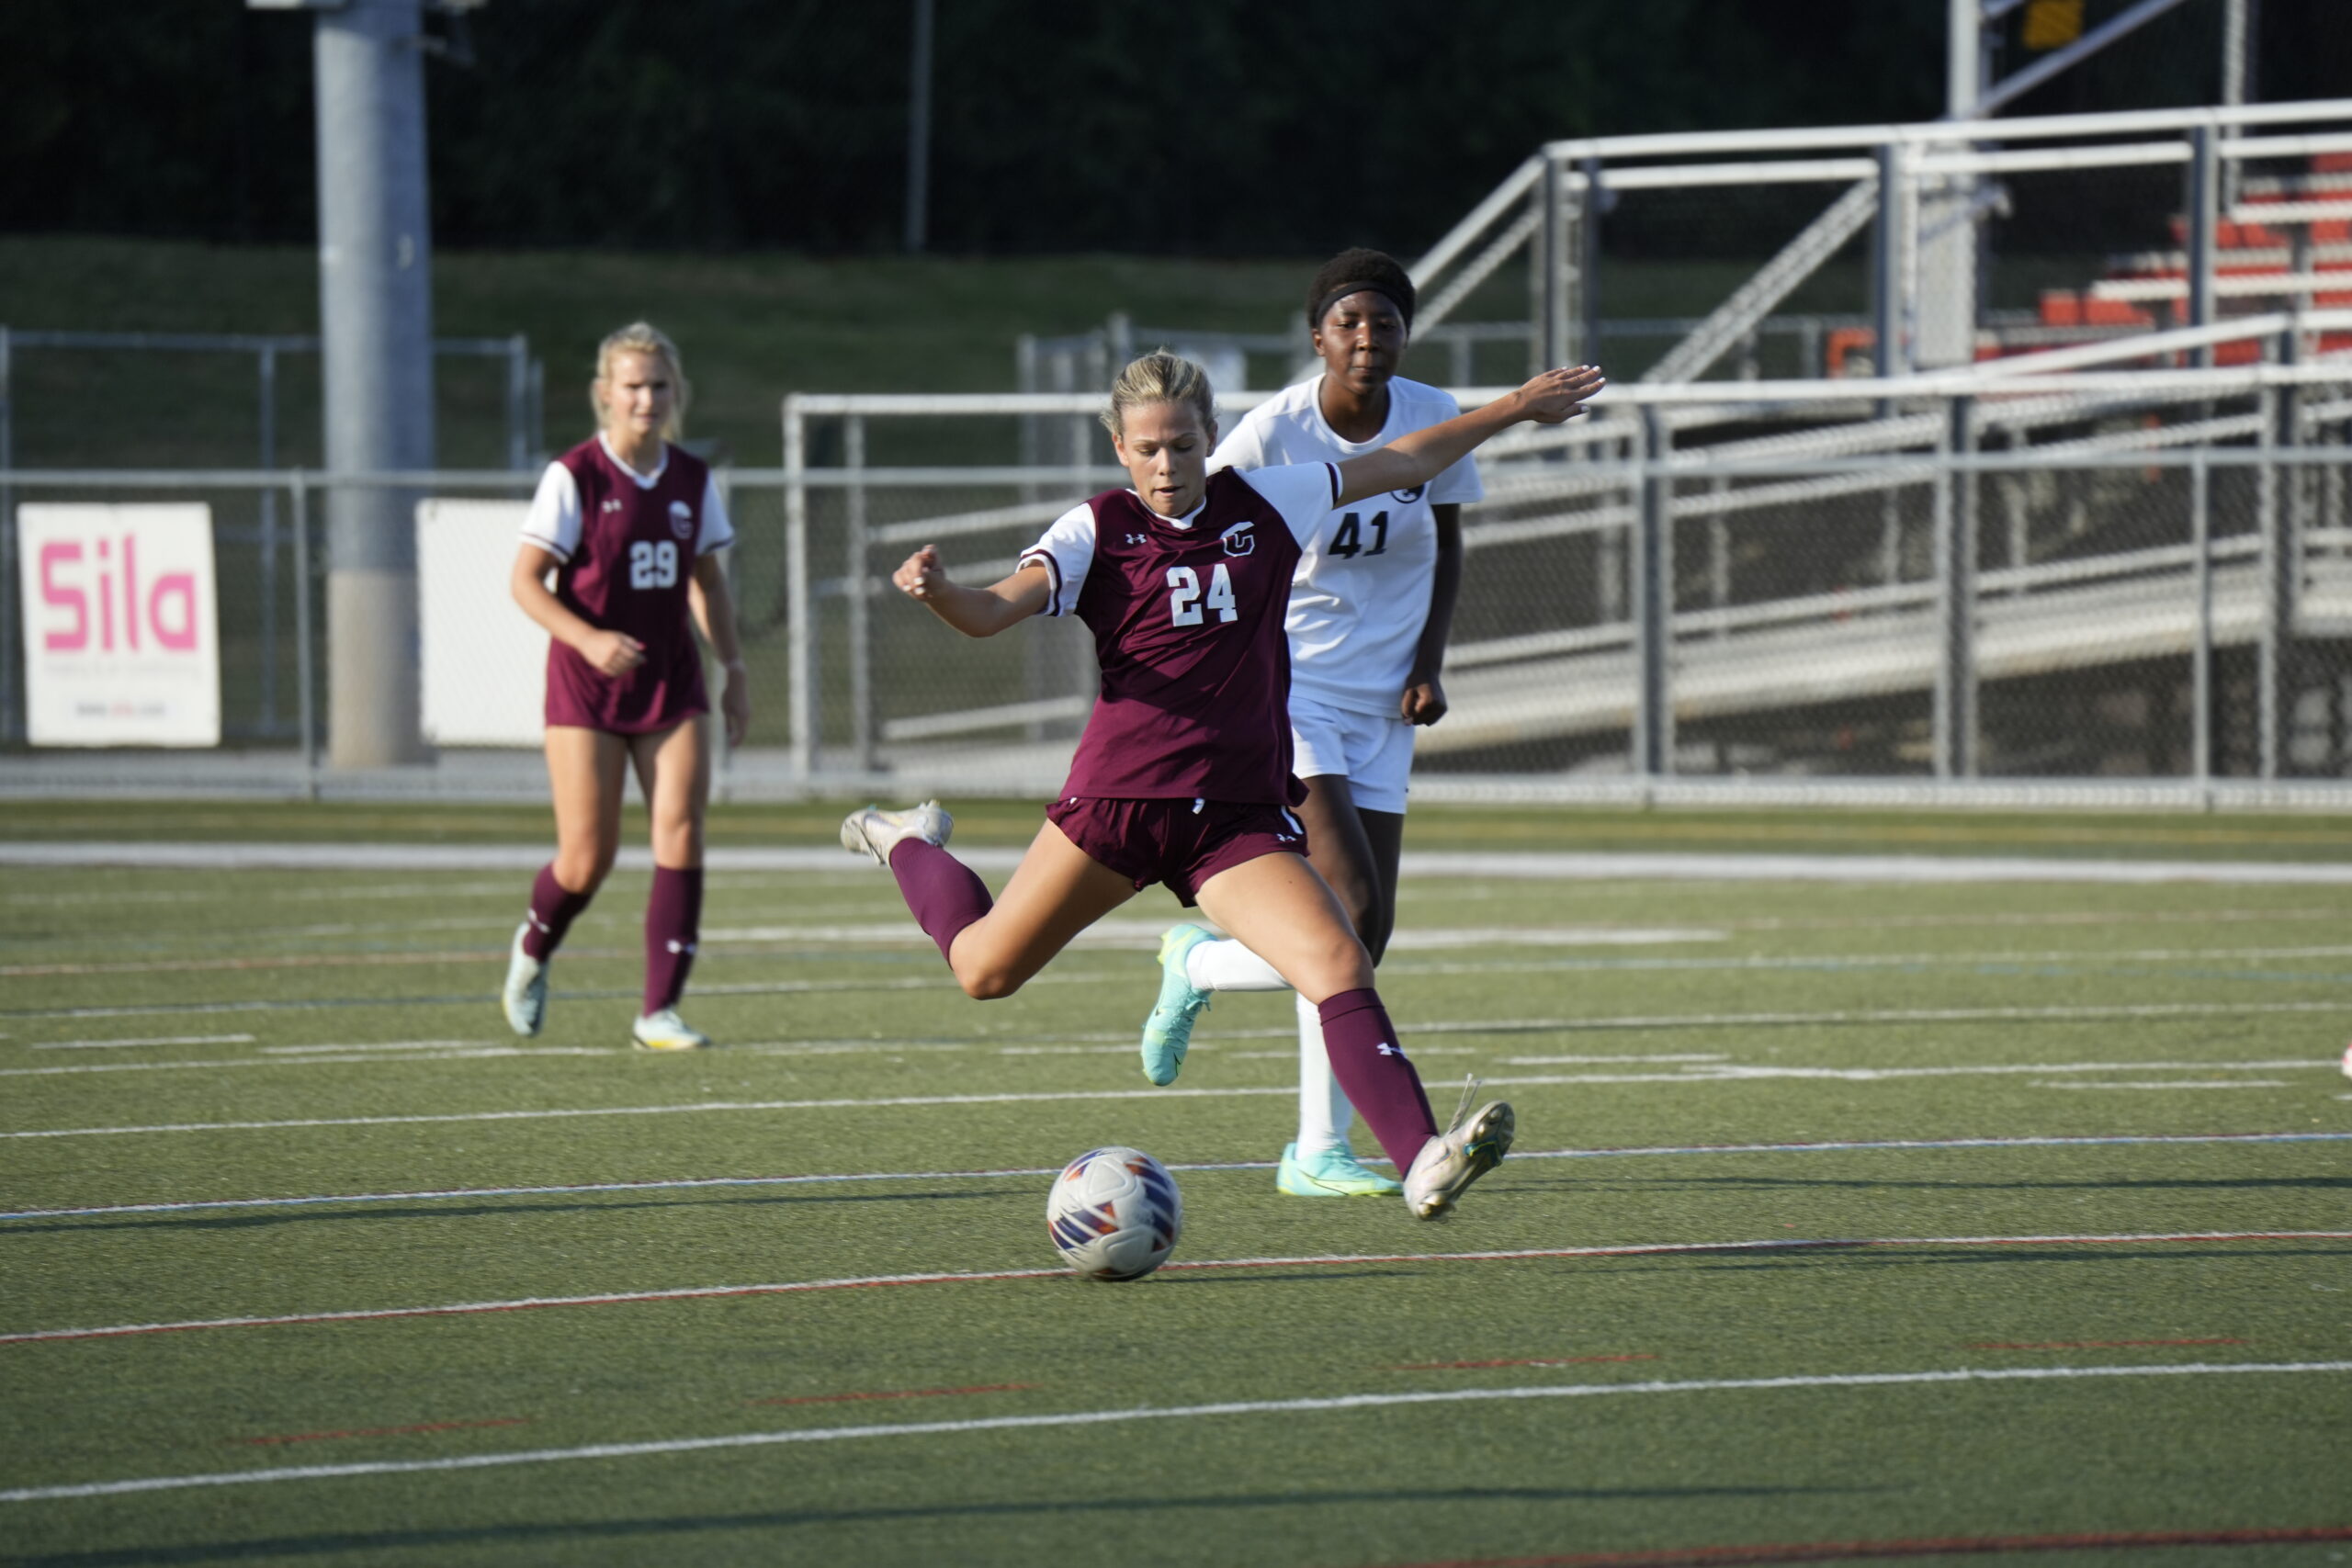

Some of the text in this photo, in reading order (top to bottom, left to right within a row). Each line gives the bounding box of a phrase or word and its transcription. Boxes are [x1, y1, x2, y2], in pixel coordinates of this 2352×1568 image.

[1328, 511, 1388, 559] 41
[40, 532, 198, 651] Sila
[630, 541, 678, 590] 29
[1166, 563, 1238, 627] 24
